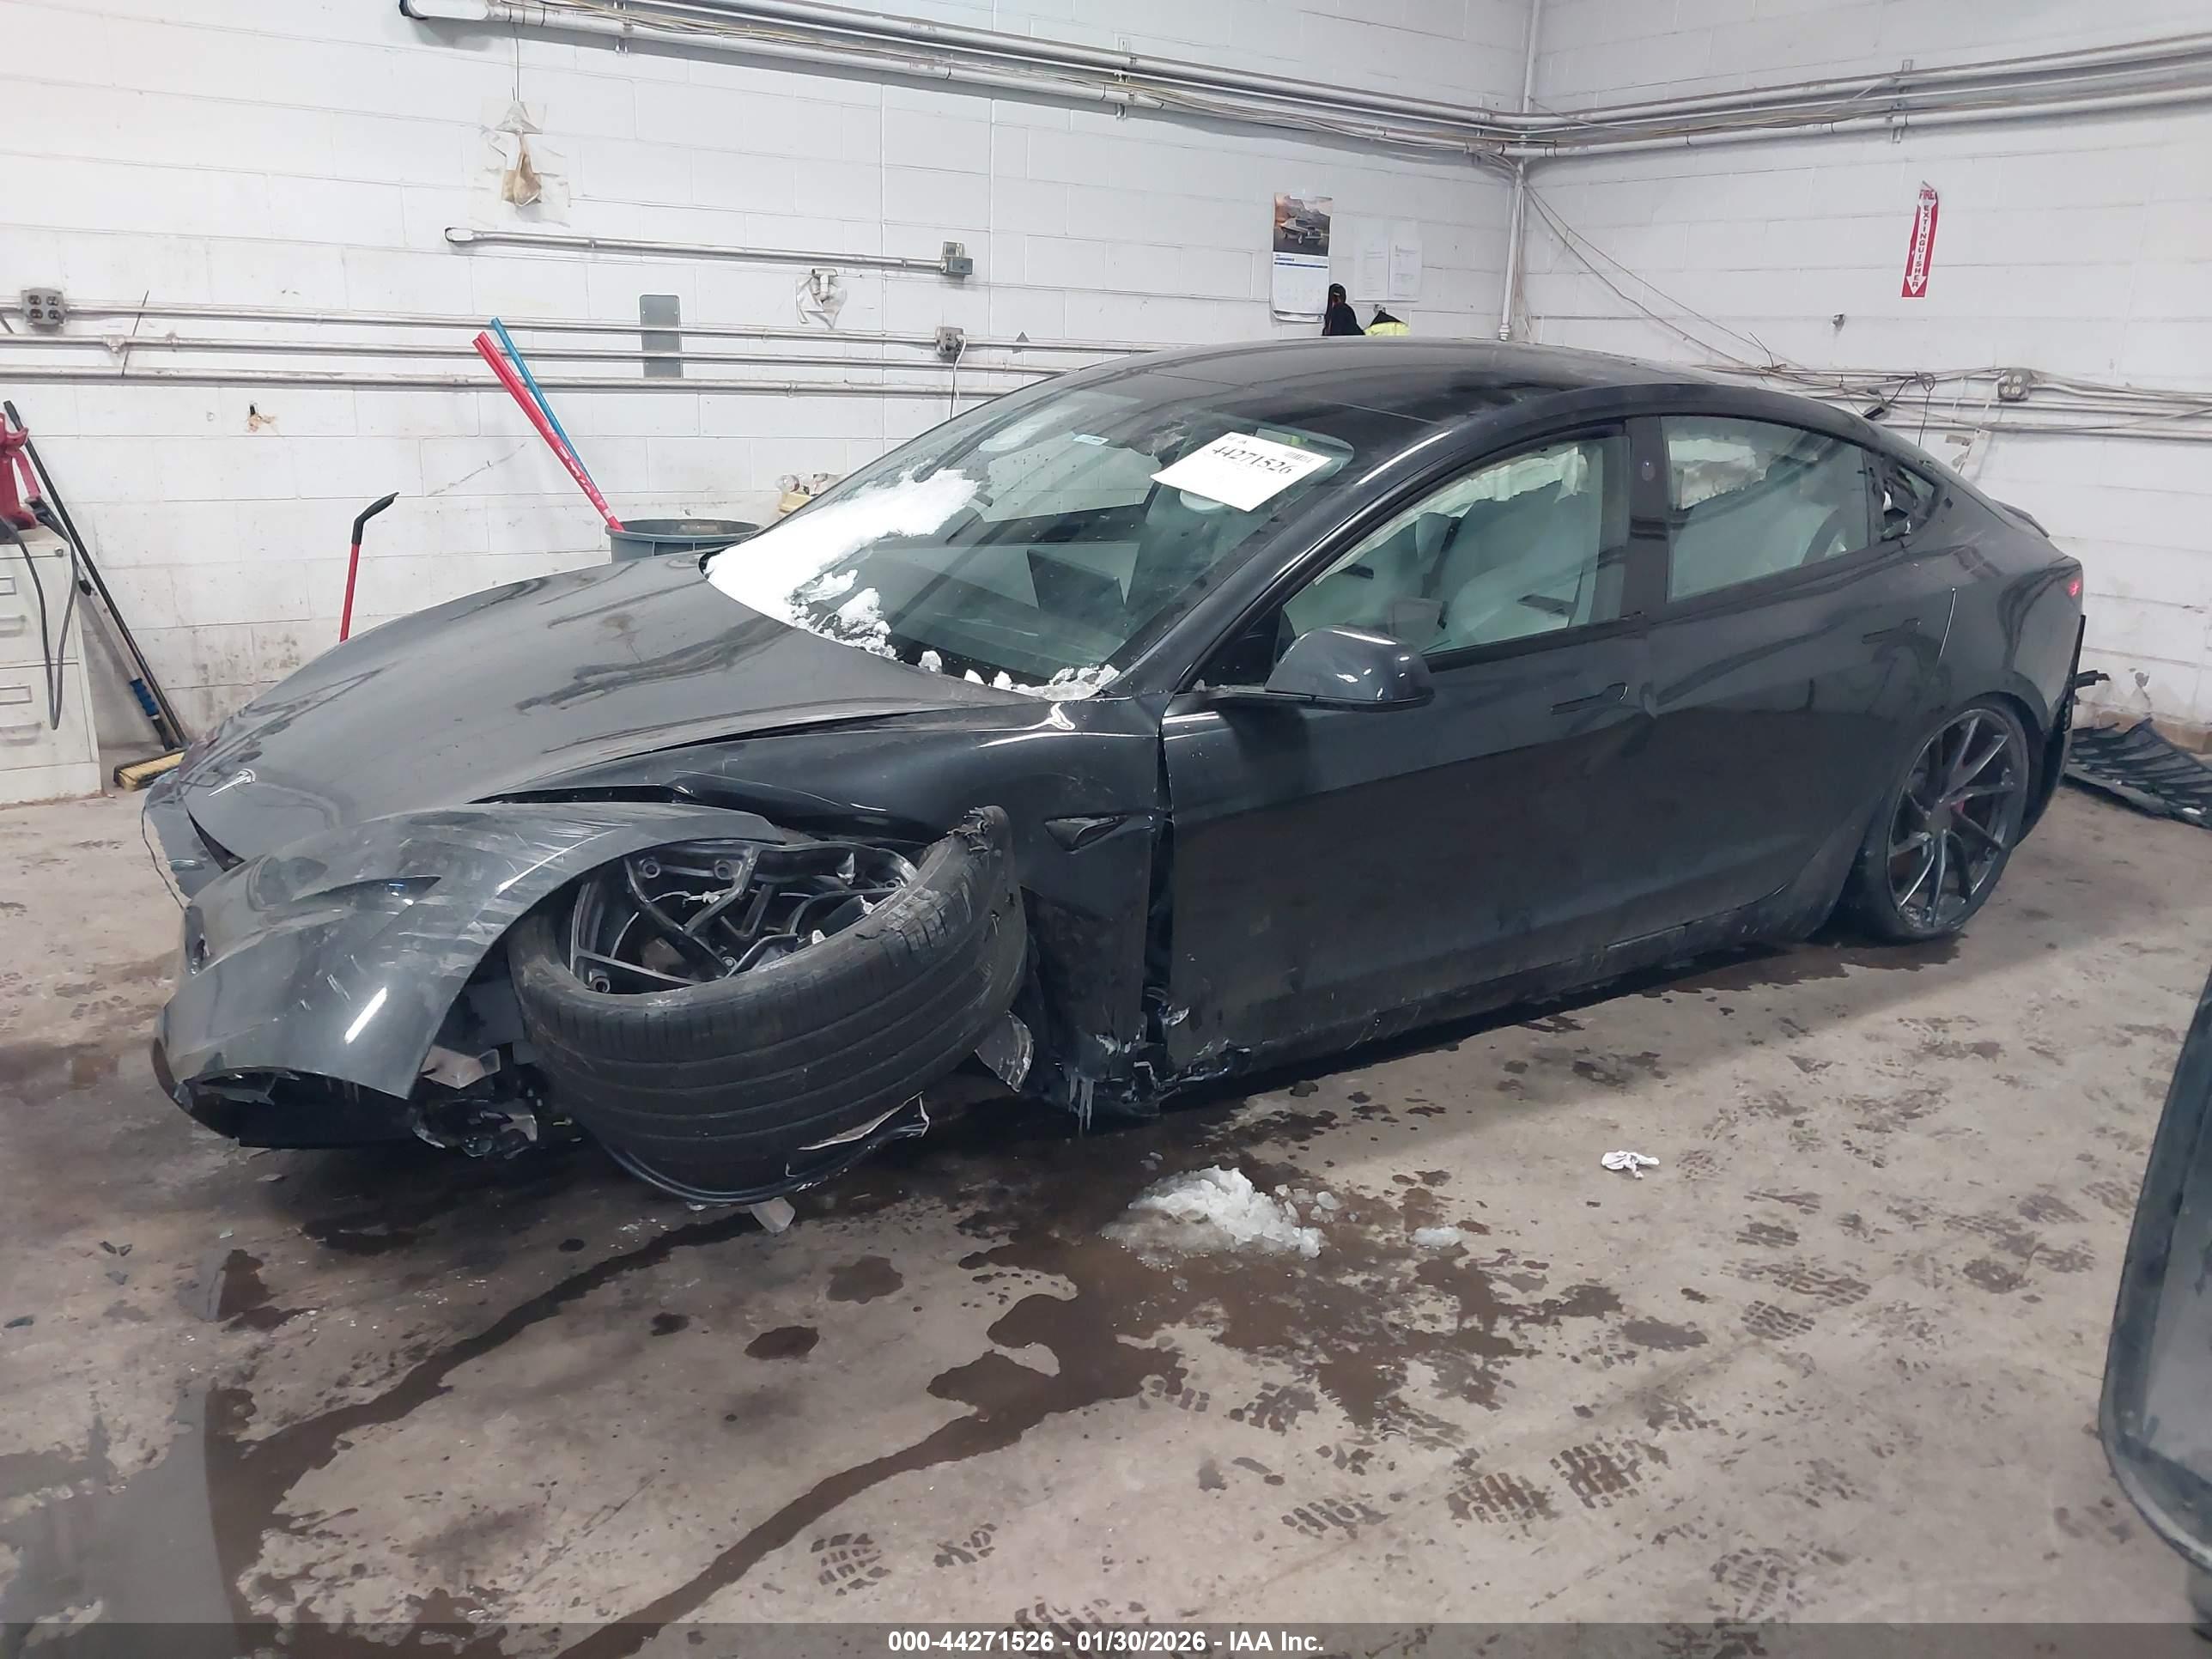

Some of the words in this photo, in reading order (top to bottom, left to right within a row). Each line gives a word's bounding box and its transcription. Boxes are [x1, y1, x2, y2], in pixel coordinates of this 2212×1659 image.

[1919, 189, 1935, 200] FIRE
[1911, 205, 1929, 288] EXTINGUISHER
[1212, 446, 1296, 474] 44271526
